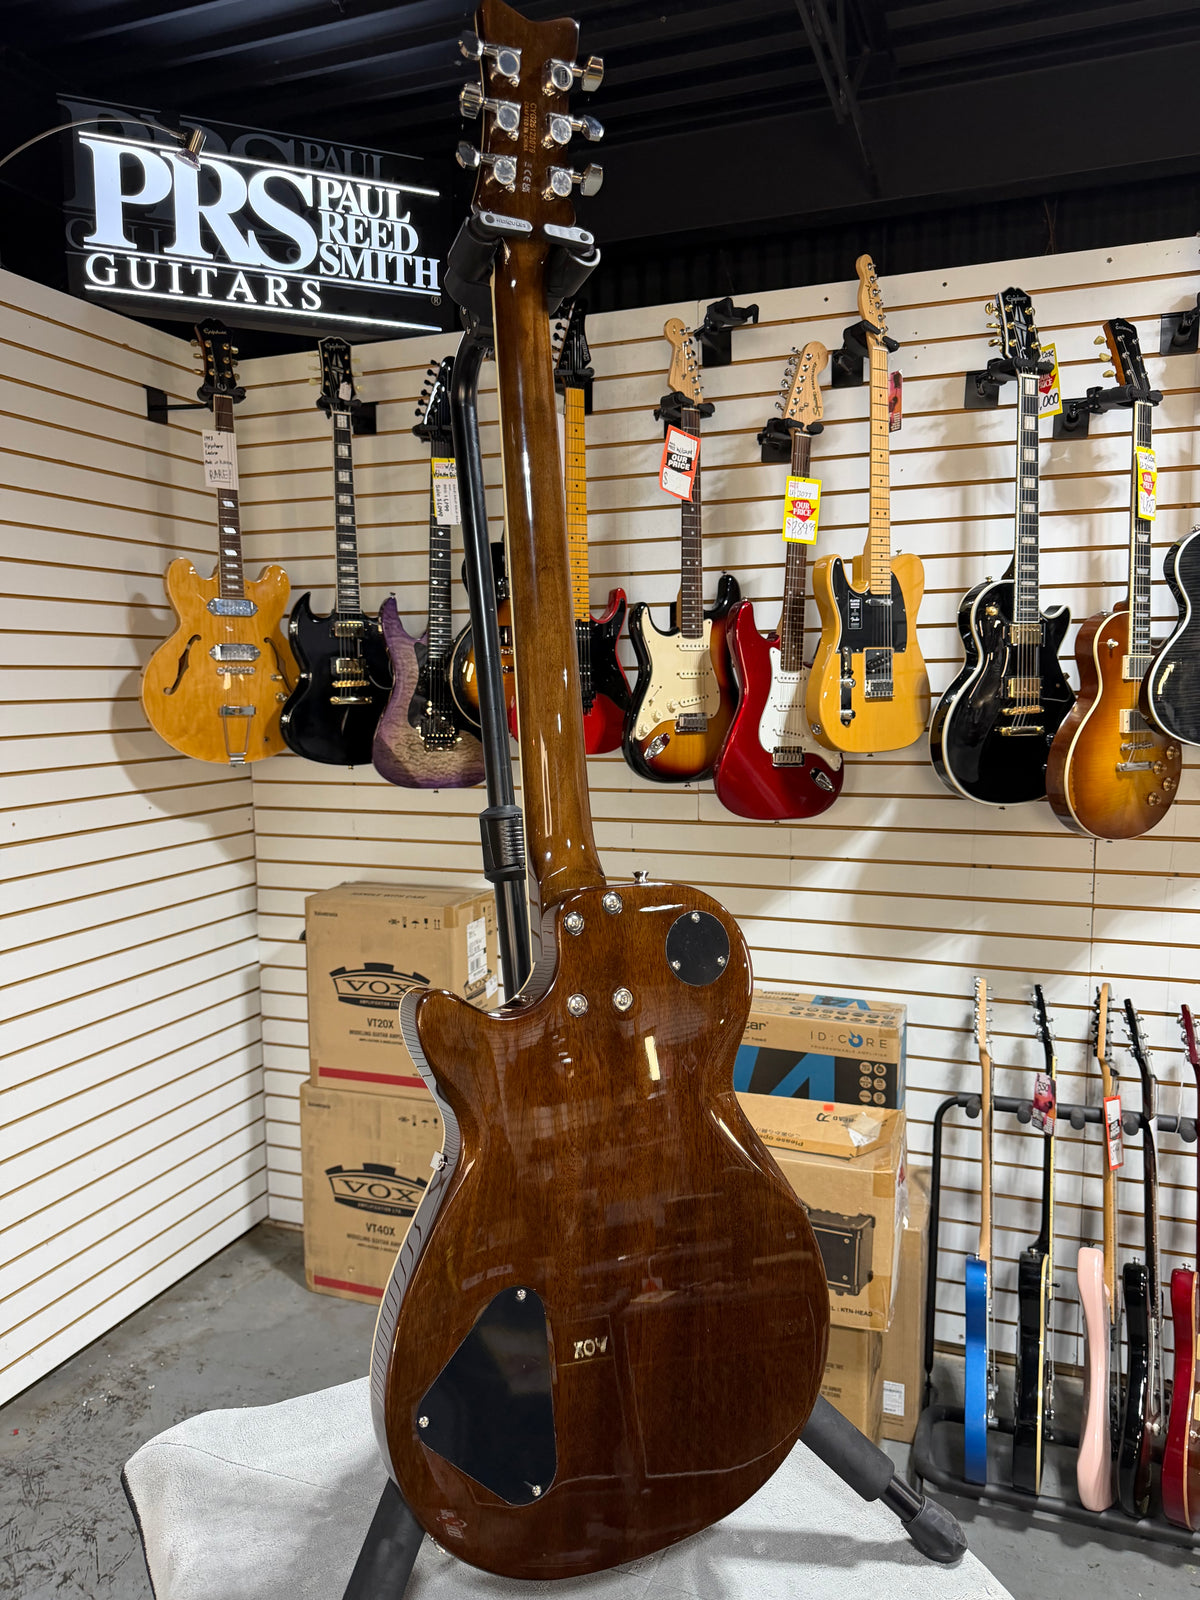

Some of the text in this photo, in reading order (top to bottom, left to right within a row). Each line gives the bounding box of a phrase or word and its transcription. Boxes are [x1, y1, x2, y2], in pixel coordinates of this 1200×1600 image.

[79, 137, 318, 271] PRS
[318, 177, 411, 224] PAUL
[319, 210, 420, 255] REED
[319, 243, 441, 290] SMITH
[85, 253, 322, 311] GUITARS
[667, 460, 691, 471] PRICE
[671, 454, 688, 463] OUR
[793, 508, 812, 517] PRICE
[795, 501, 810, 509] OUR
[343, 980, 413, 996] VOX
[367, 1017, 394, 1029] VT20X
[340, 1179, 419, 1203] VOX
[366, 1222, 396, 1236] VT40X
